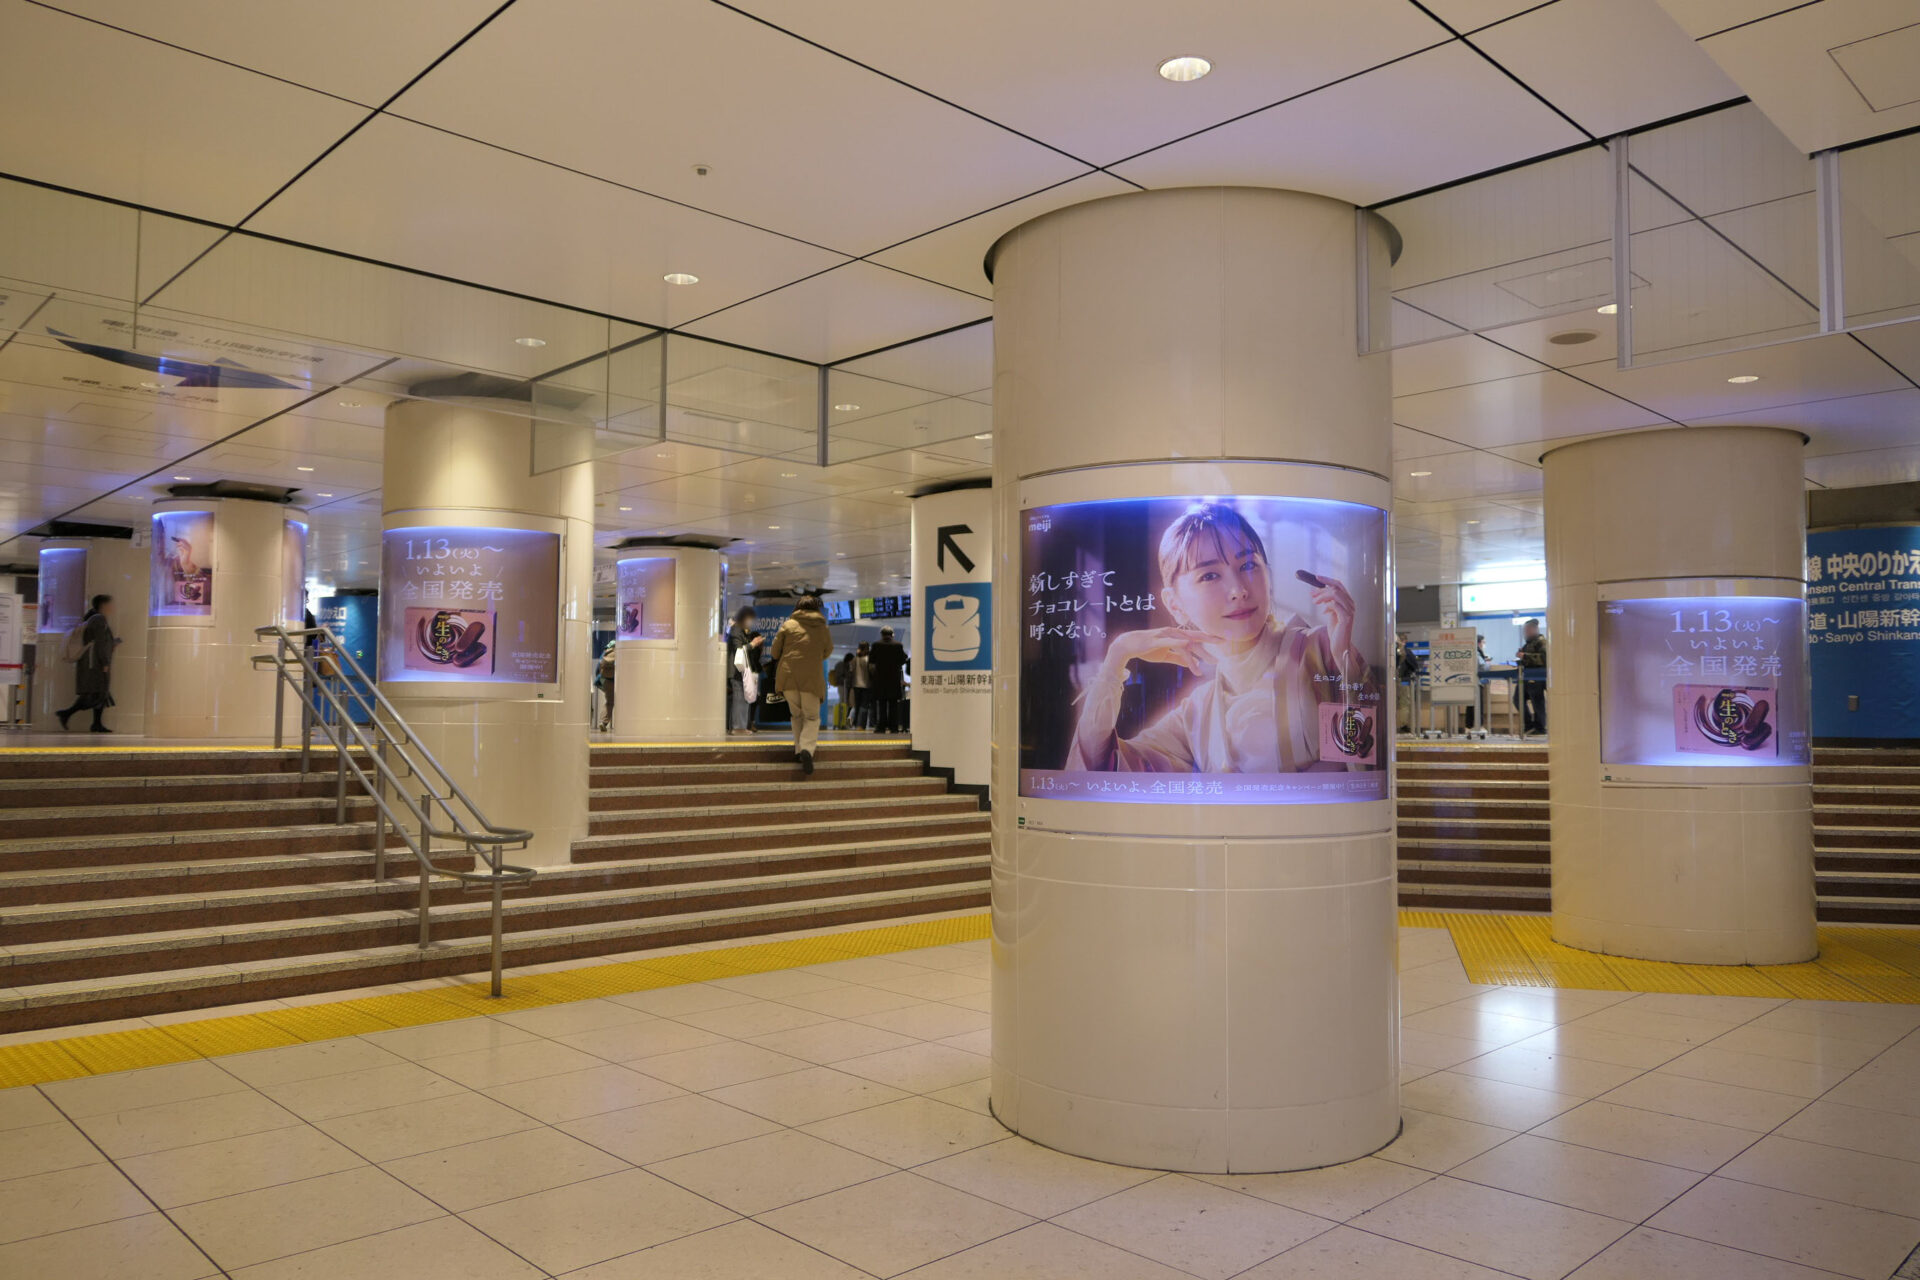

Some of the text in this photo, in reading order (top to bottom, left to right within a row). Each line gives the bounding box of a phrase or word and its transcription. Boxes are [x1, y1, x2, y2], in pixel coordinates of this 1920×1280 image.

[1028, 519, 1052, 532] meiji
[416, 563, 483, 577] いよいよ
[400, 580, 504, 601] 全国発売
[1028, 570, 1116, 596] 新しすぎて
[1839, 580, 1886, 592] Central
[1028, 593, 1156, 617] チョコレートとは
[434, 621, 451, 661] 生のとき
[1029, 620, 1107, 641] 呼べない。
[1690, 636, 1766, 651] いよいよ
[1668, 655, 1783, 677] 全国発売
[1719, 700, 1738, 744] 生のとき
